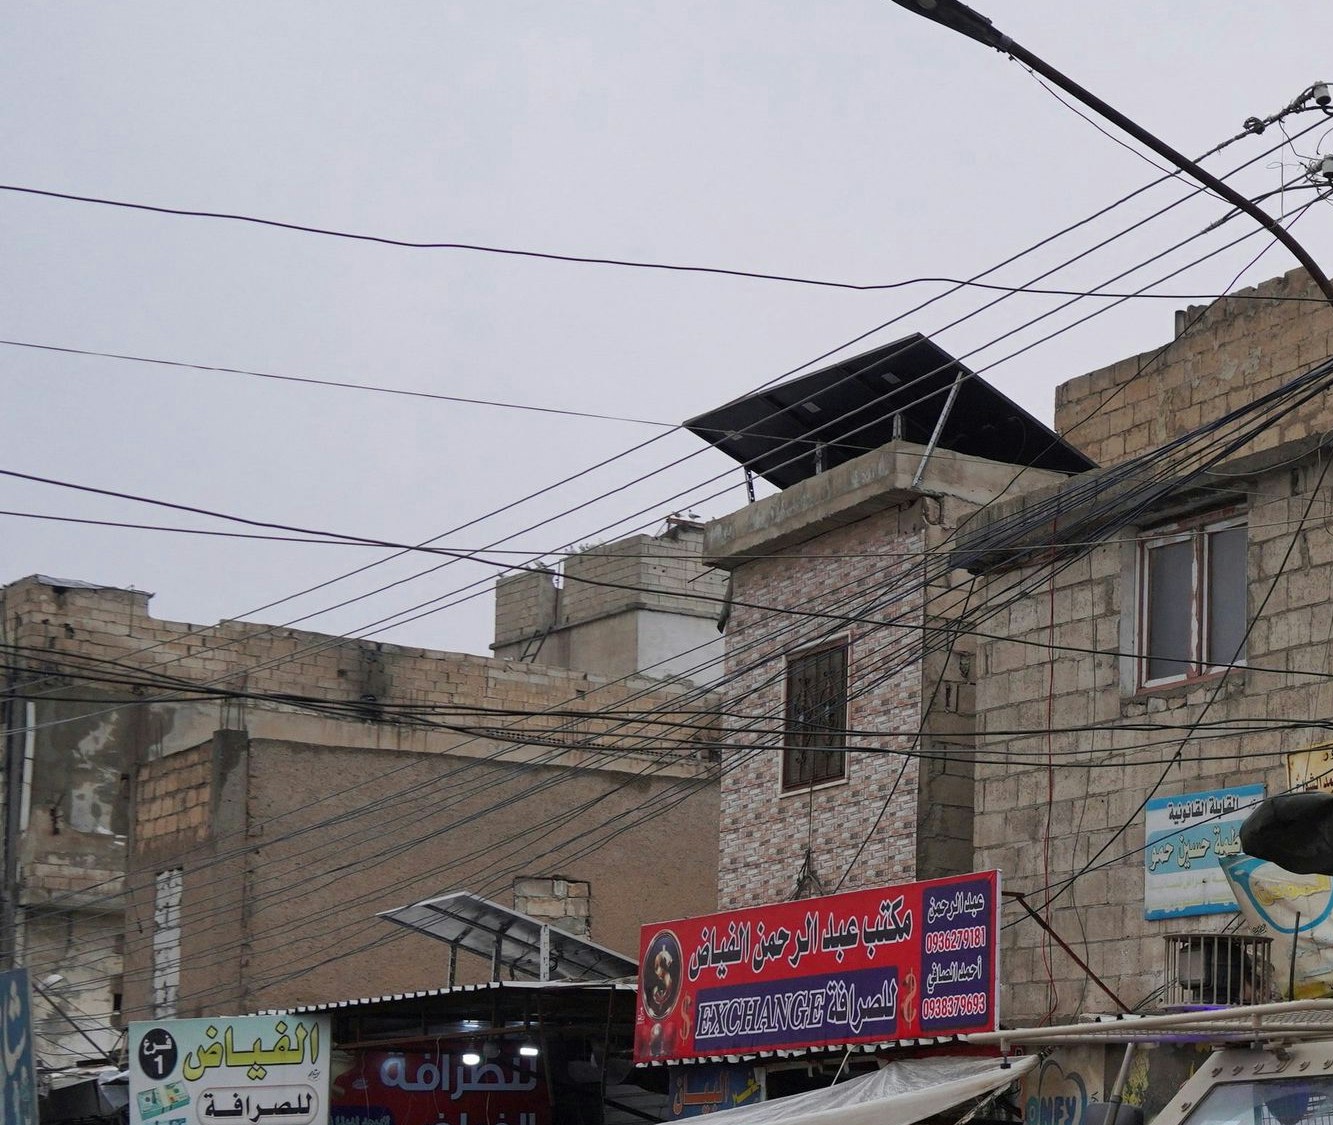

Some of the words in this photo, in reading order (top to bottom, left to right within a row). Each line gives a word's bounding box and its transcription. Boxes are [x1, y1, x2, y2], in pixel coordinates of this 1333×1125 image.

[1168, 799, 1208, 824] القانونية
[1209, 794, 1239, 819] القابلة
[1149, 843, 1174, 871] حمو
[1177, 835, 1210, 868] حسين
[927, 891, 964, 923] الرحمن
[964, 892, 985, 918] عبد
[751, 911, 820, 974] الرحمن
[821, 911, 860, 964] عبد
[861, 894, 914, 960] مكتب
[925, 925, 987, 955] 0936279181
[688, 920, 751, 983] الفياض
[695, 988, 826, 1039] EXCHANGE
[826, 978, 899, 1034] للصرافة
[922, 992, 987, 1021] 0938379693
[143, 1035, 172, 1055] فرع
[182, 1020, 320, 1082] الفياض
[154, 1056, 163, 1075] 1
[203, 1091, 313, 1123] للصرافة
